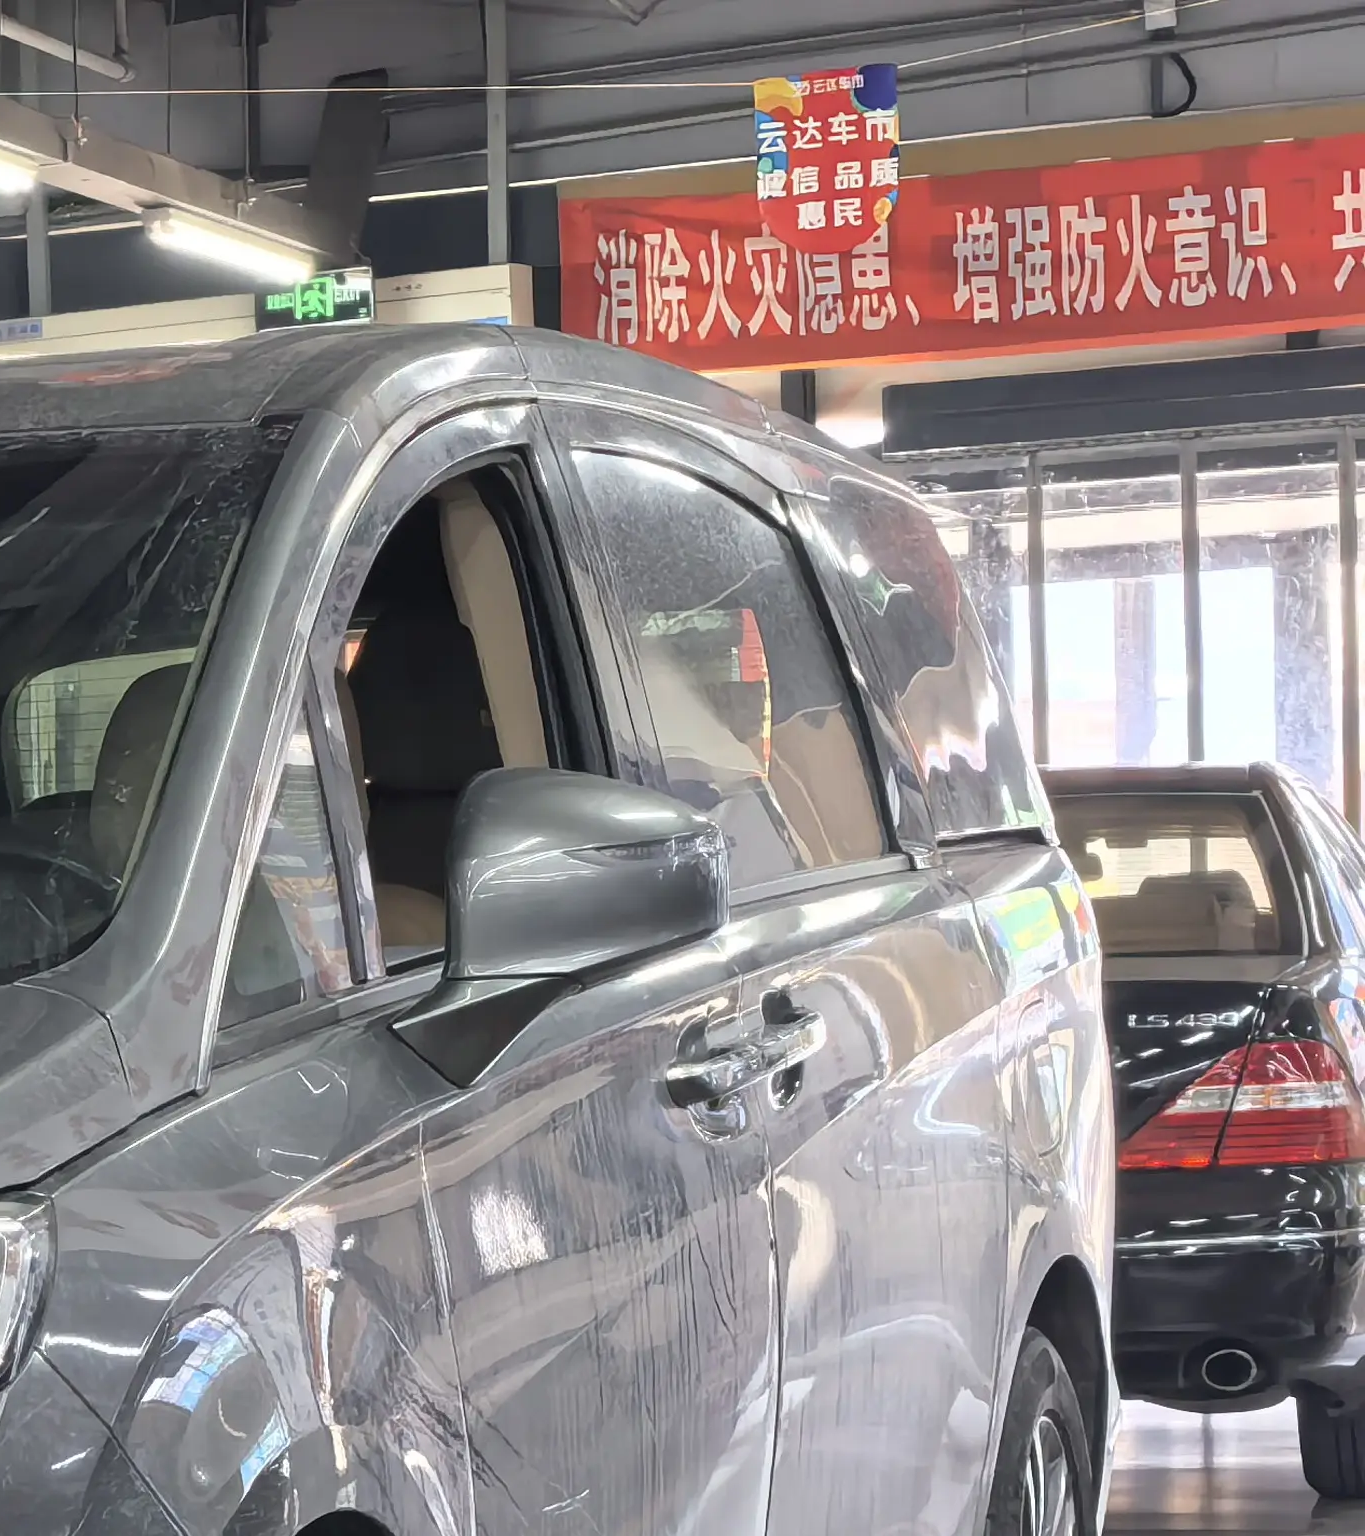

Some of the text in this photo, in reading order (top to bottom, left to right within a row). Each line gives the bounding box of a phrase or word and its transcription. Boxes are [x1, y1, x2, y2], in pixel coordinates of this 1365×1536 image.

[757, 109, 896, 153] 云达车市
[834, 157, 899, 190] 品质
[796, 198, 863, 230] 惠民
